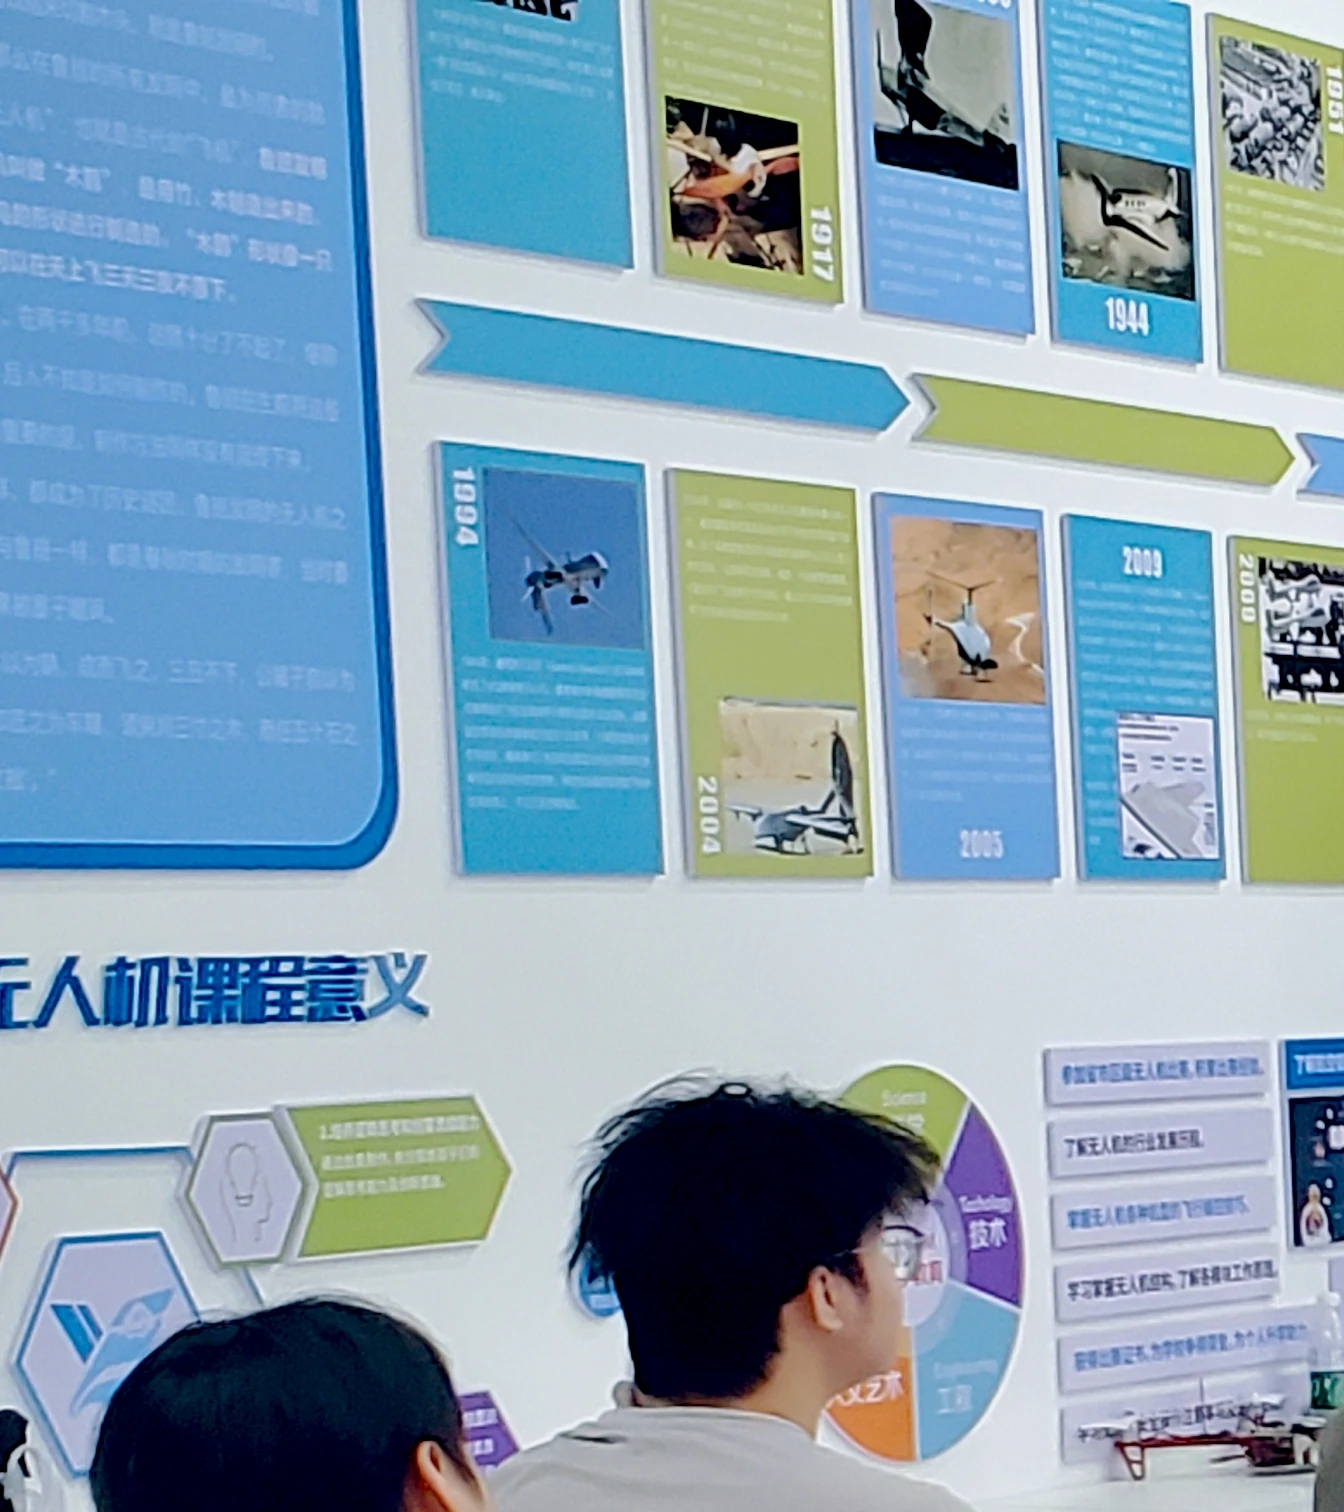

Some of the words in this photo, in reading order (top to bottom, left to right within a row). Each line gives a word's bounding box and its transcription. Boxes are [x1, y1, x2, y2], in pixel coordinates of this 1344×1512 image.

[810, 206, 836, 283] 1917
[1104, 297, 1151, 337] 1944
[450, 465, 480, 548] 1994
[1122, 545, 1163, 578] 2009
[697, 775, 722, 857] 2004
[959, 830, 1004, 860] 2005
[968, 1218, 1009, 1252] 技术
